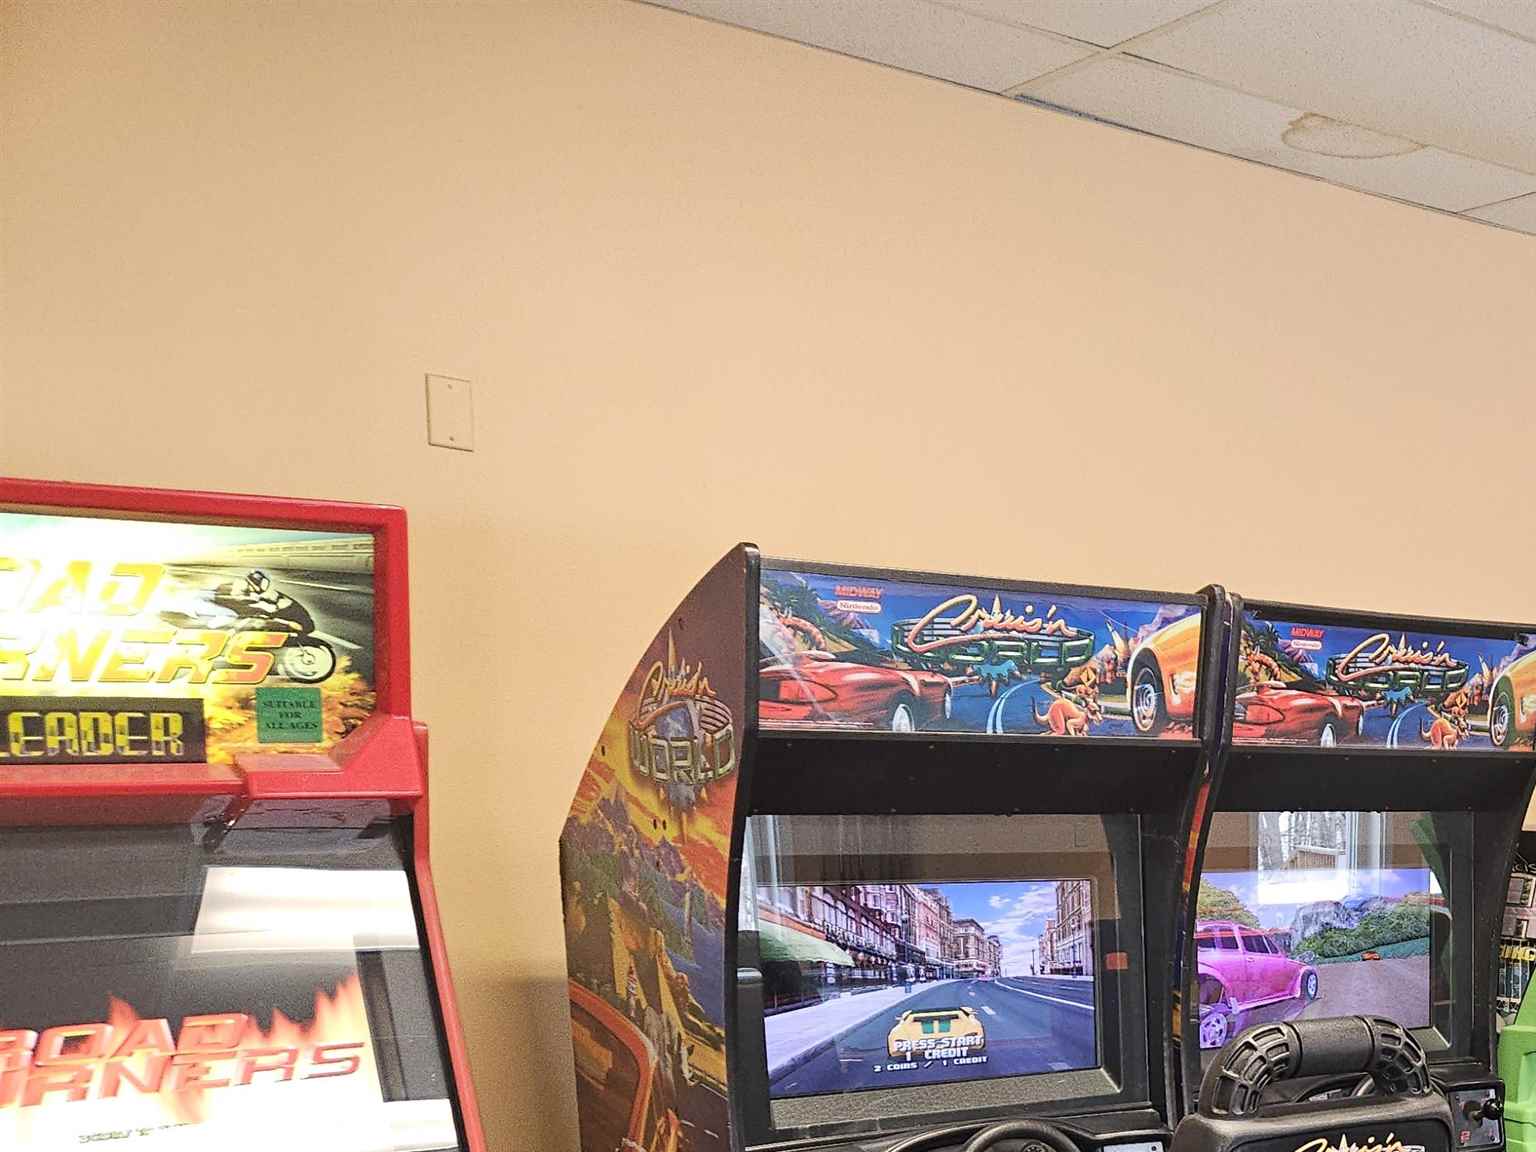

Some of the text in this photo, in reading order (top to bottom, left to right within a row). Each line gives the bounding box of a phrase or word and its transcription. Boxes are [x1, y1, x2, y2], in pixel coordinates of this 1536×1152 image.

[833, 585, 883, 599] MIDWAY
[908, 595, 1077, 654] Cruis'n
[1337, 633, 1458, 681] Cruis'n
[279, 711, 302, 719] FOR
[265, 722, 318, 730] ALL AGES
[893, 1034, 983, 1051] PRESS START
[906, 1047, 968, 1061] 1 CREDIT
[887, 1062, 918, 1071] COINS
[953, 1055, 988, 1065] CREDIT
